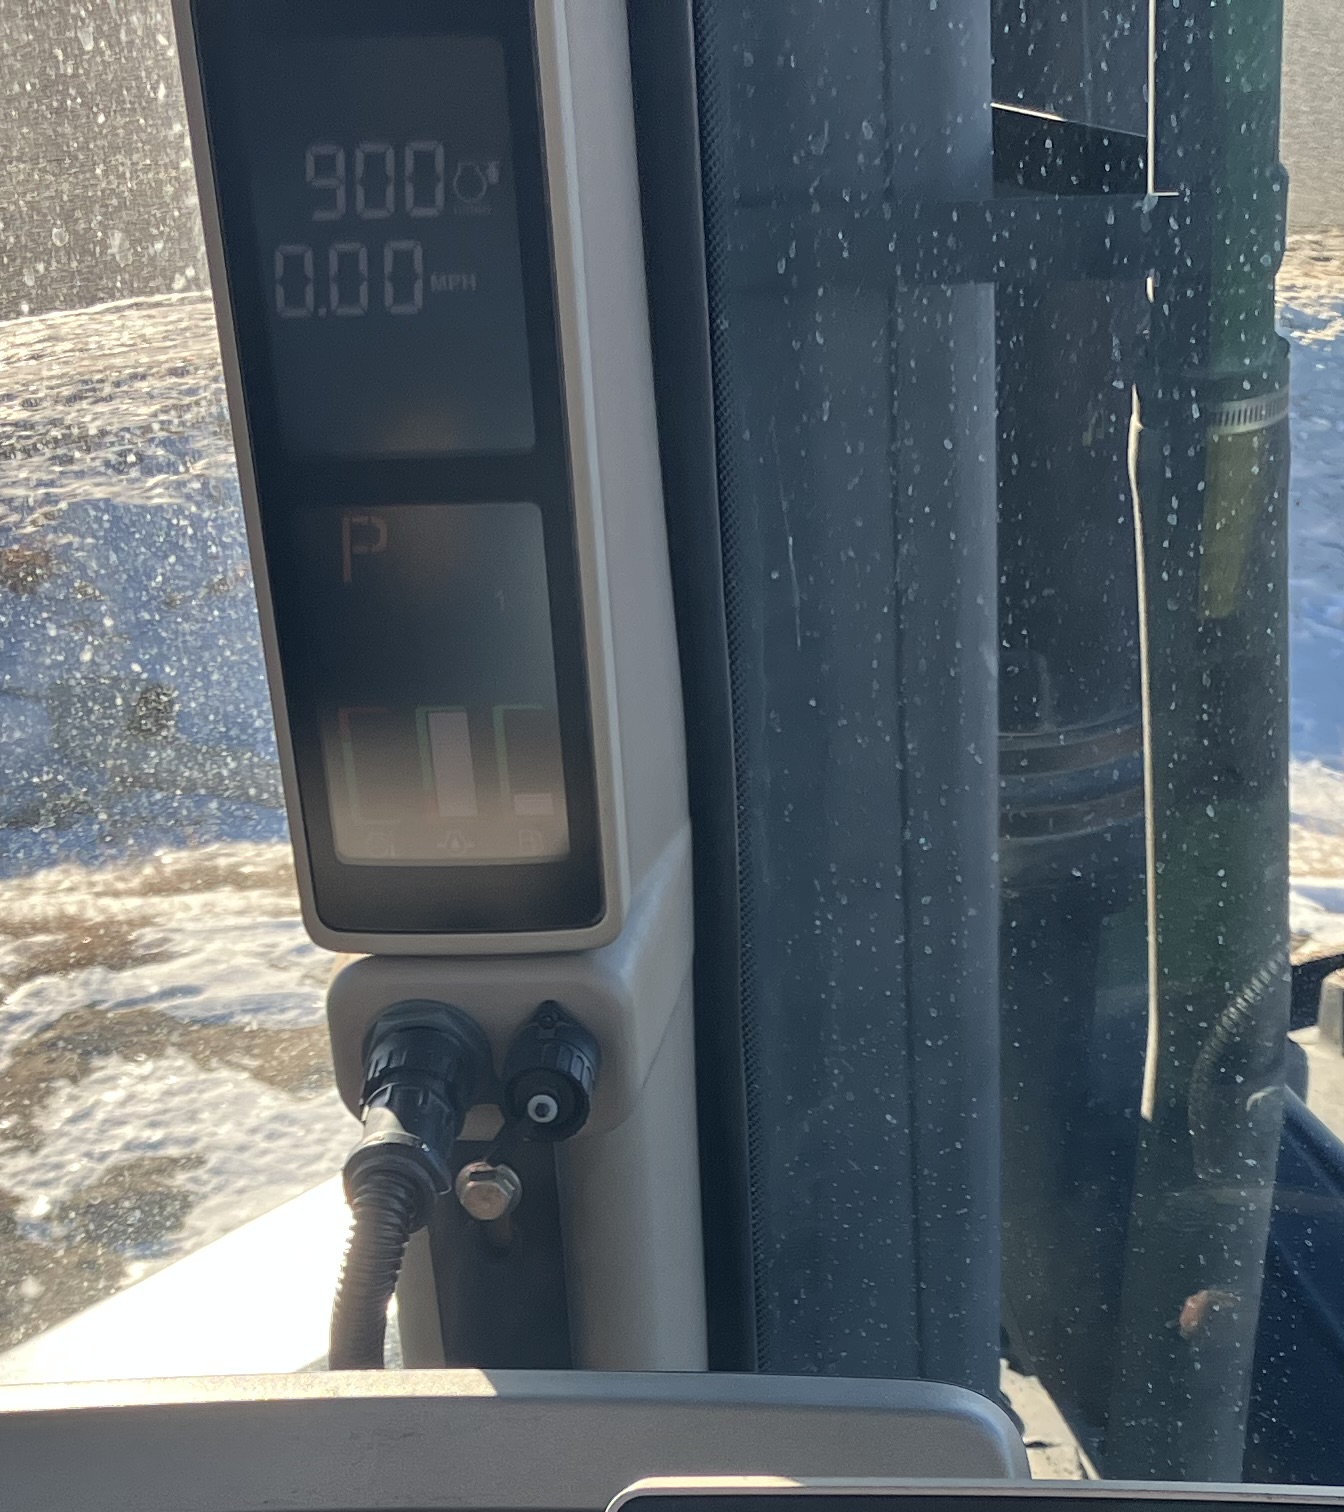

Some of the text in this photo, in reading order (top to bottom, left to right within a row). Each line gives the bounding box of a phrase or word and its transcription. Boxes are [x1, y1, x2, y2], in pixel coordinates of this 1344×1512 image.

[305, 140, 446, 223] 900
[274, 240, 477, 320] 0.00 MPH
[341, 513, 389, 584] P
